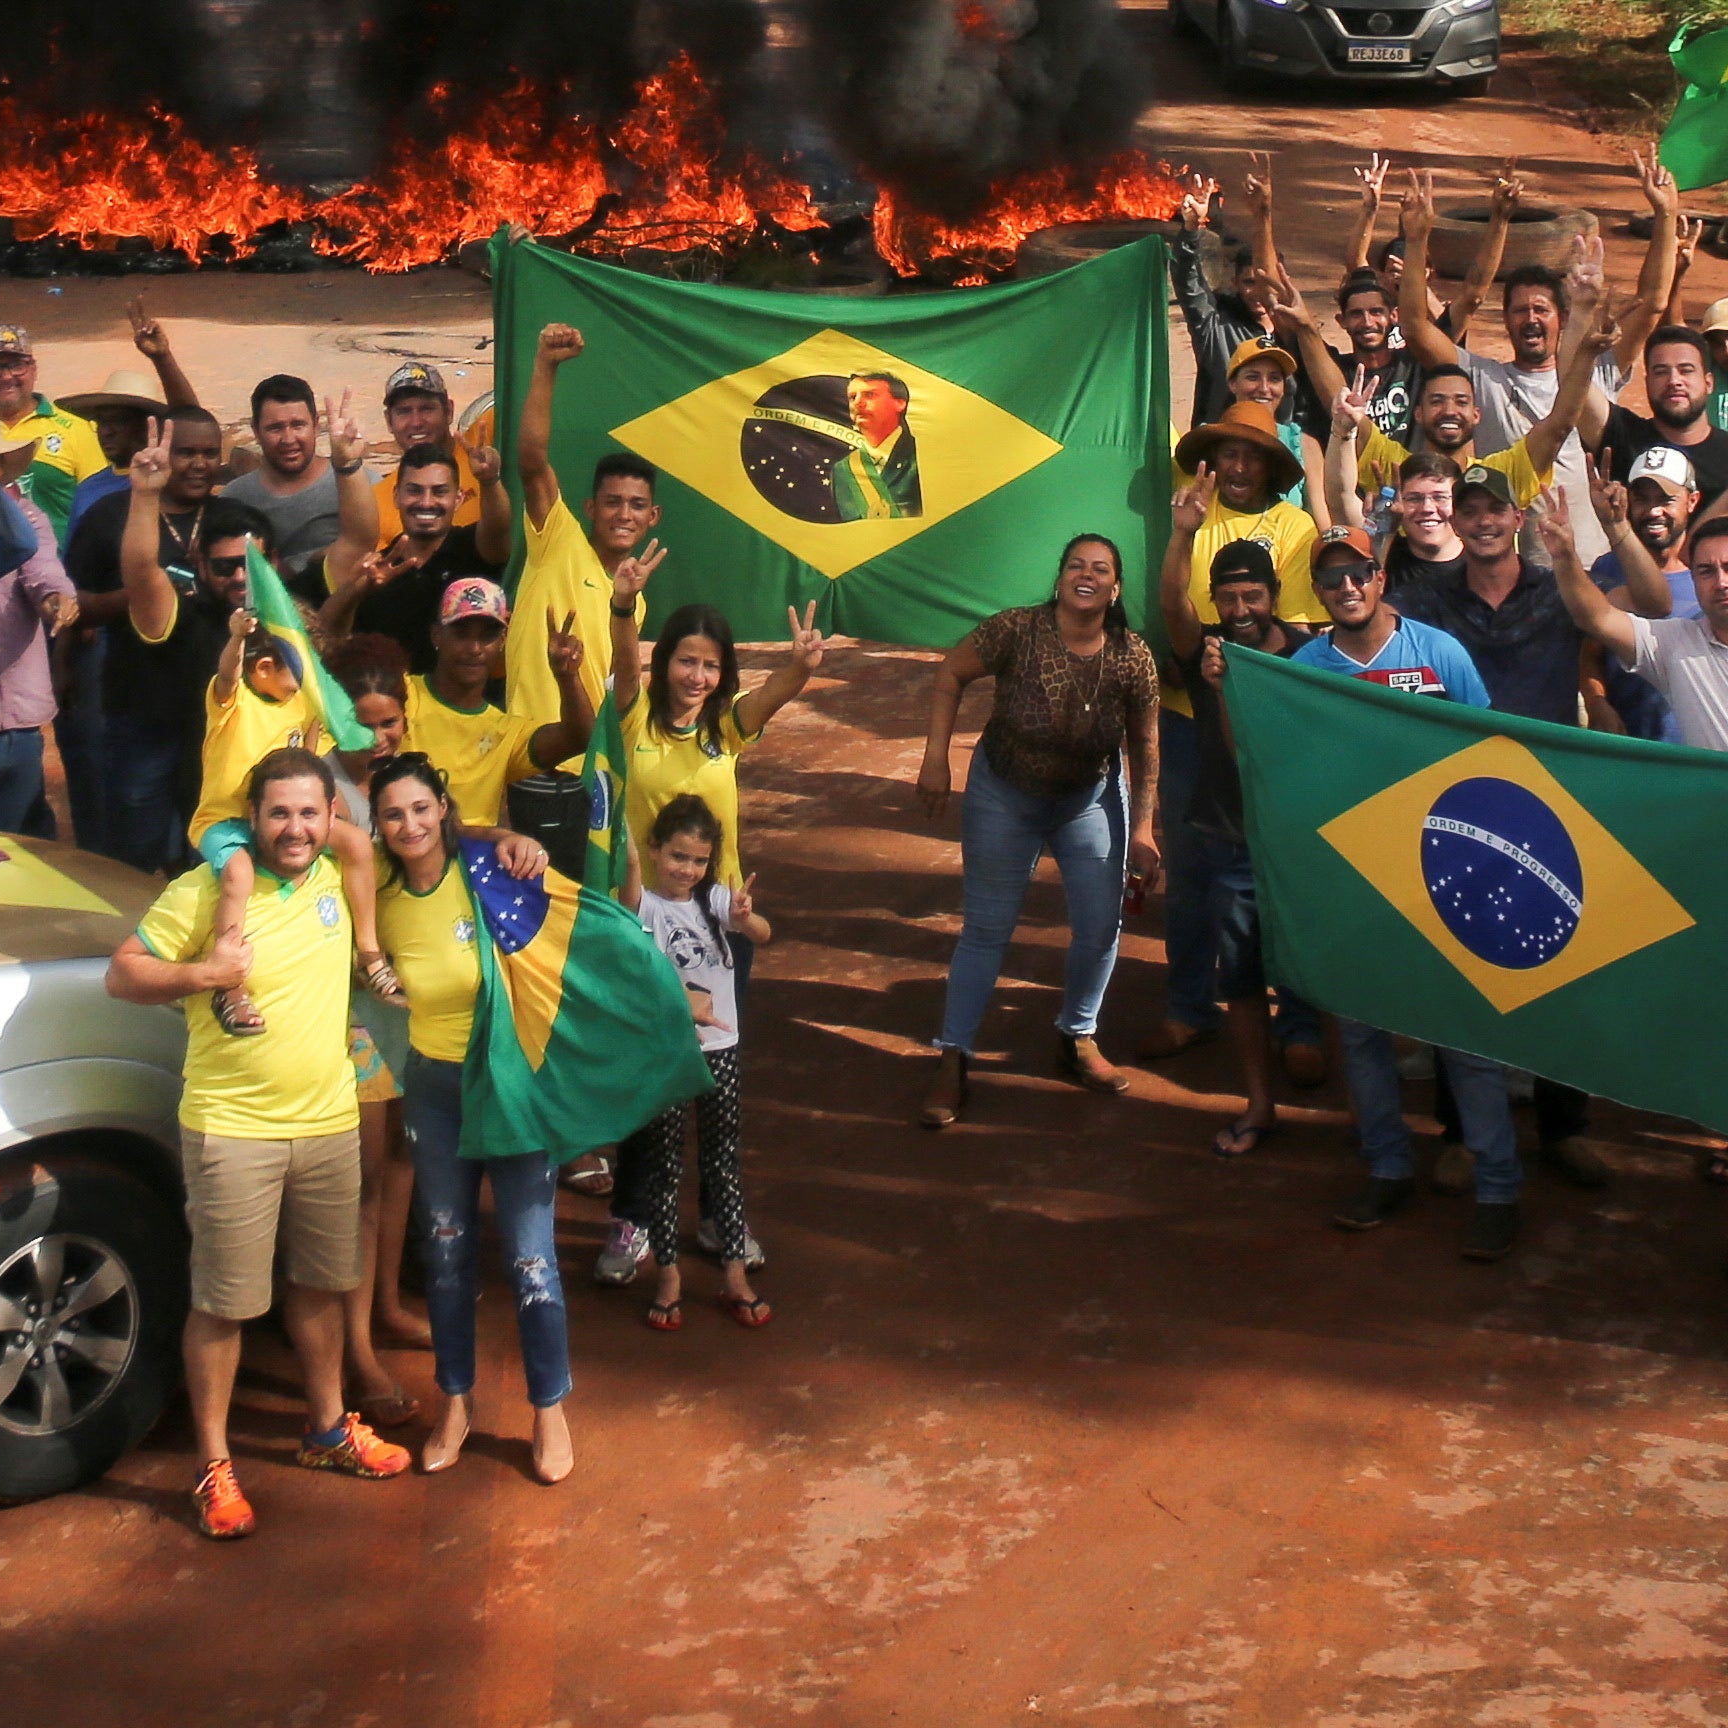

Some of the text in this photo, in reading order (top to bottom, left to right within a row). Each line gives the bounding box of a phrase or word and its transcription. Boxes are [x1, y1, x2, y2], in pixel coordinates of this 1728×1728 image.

[1352, 48, 1404, 60] REJ3E68
[753, 408, 806, 426] ORDEM
[813, 421, 821, 429] E
[1392, 674, 1420, 685] SPFC
[1429, 817, 1578, 909] ORDEM E PROGRESSO
